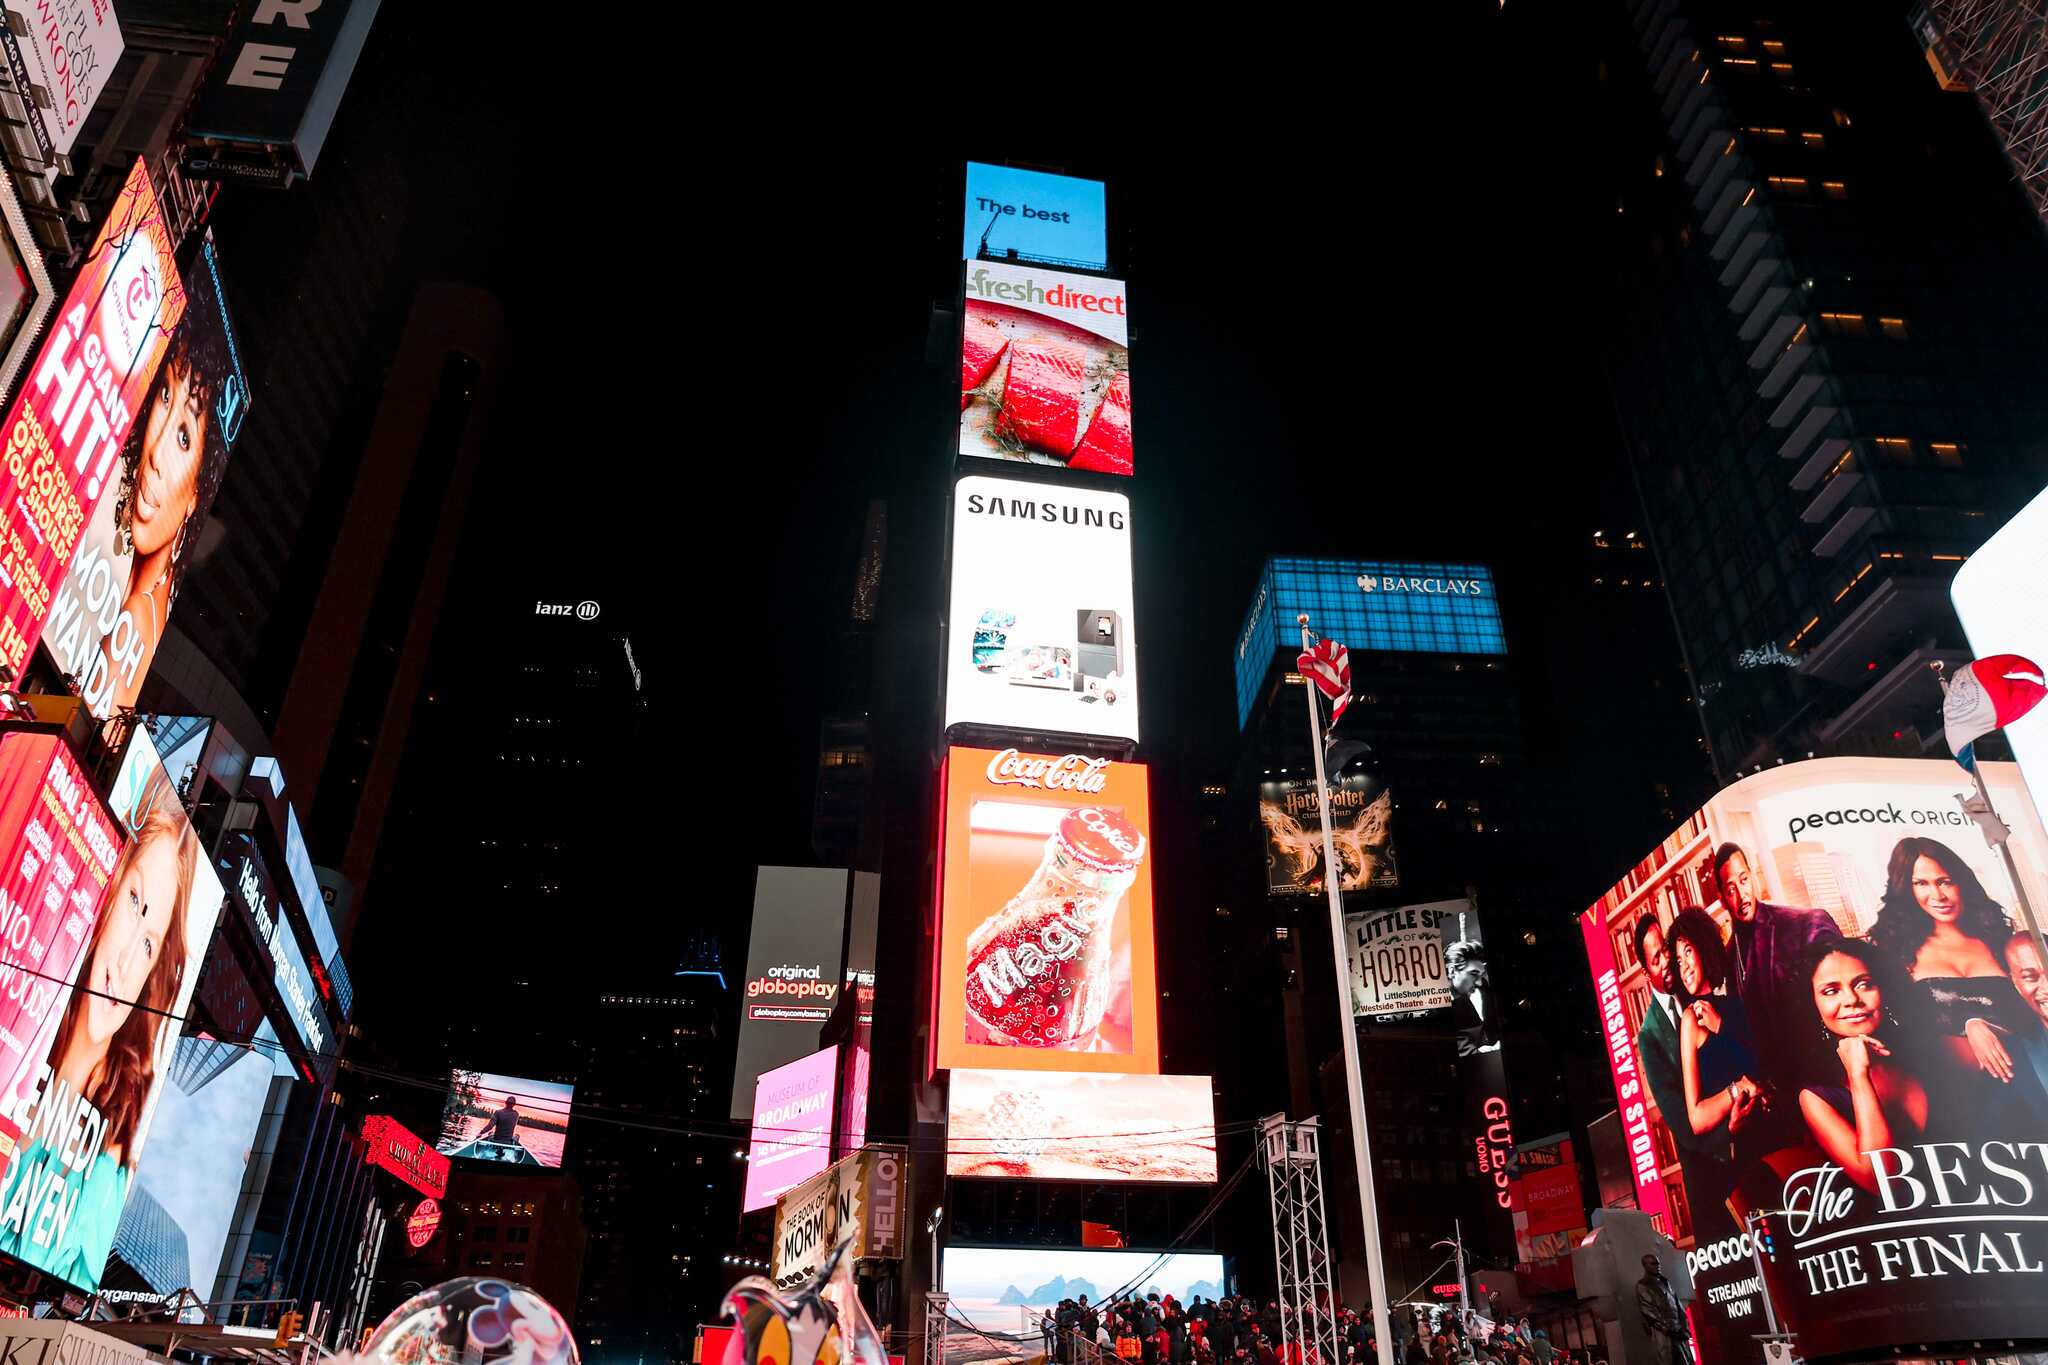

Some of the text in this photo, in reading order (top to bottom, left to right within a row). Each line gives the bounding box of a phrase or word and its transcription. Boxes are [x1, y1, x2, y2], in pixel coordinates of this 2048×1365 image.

[37, 0, 80, 127] WRONG
[74, 11, 99, 73] PLAY
[65, 31, 93, 105] GOES
[5, 33, 17, 61] 340
[30, 109, 49, 152] STREET
[976, 197, 1071, 224] The best
[972, 269, 1126, 316] freshdirect
[66, 302, 131, 436] A GIANT
[35, 324, 118, 501] HIT!
[4, 438, 31, 490] YOU
[13, 420, 36, 460] OF
[32, 456, 79, 548] COURSE
[53, 460, 70, 496] YOU
[68, 494, 85, 526] GO?
[968, 494, 1125, 531] SAMSUNG
[3, 553, 14, 571] A
[10, 527, 28, 561] YOU
[24, 557, 42, 588] CAN
[38, 579, 51, 603] TO
[535, 601, 574, 616] ianz
[1382, 577, 1482, 595] BARCLAYS
[1, 614, 28, 667] THE
[48, 755, 80, 816] FINAL
[75, 801, 88, 827] 3
[1078, 808, 1139, 855] Coke
[1788, 803, 1906, 844] peacock
[239, 856, 260, 914] Hello
[256, 895, 273, 943] from
[28, 936, 44, 963] THE
[1356, 909, 1418, 948] LITTLE
[1403, 933, 1417, 943] OF
[747, 978, 838, 1000] globoplay
[767, 964, 821, 981] original
[1360, 1002, 1395, 1013] Westside
[1395, 999, 1425, 1010] Theatre
[1427, 996, 1442, 1006] 407
[1598, 968, 1659, 1188] HERSHEY'S STORE
[757, 1089, 829, 1128] BROADWAY
[1475, 1136, 1490, 1173] UOMO
[786, 1213, 798, 1233] THE
[797, 1203, 815, 1223] BOOK
[815, 1191, 827, 1208] OF
[873, 1152, 900, 1252] HELLO!
[1527, 1184, 1576, 1202] BROADWAY
[1783, 1162, 1855, 1238] The
[1686, 1229, 1767, 1289] peacock
[1798, 1232, 2044, 1296] THE FINAL
[1433, 1283, 1463, 1295] GUESS
[1726, 1298, 1752, 1319] NOW
